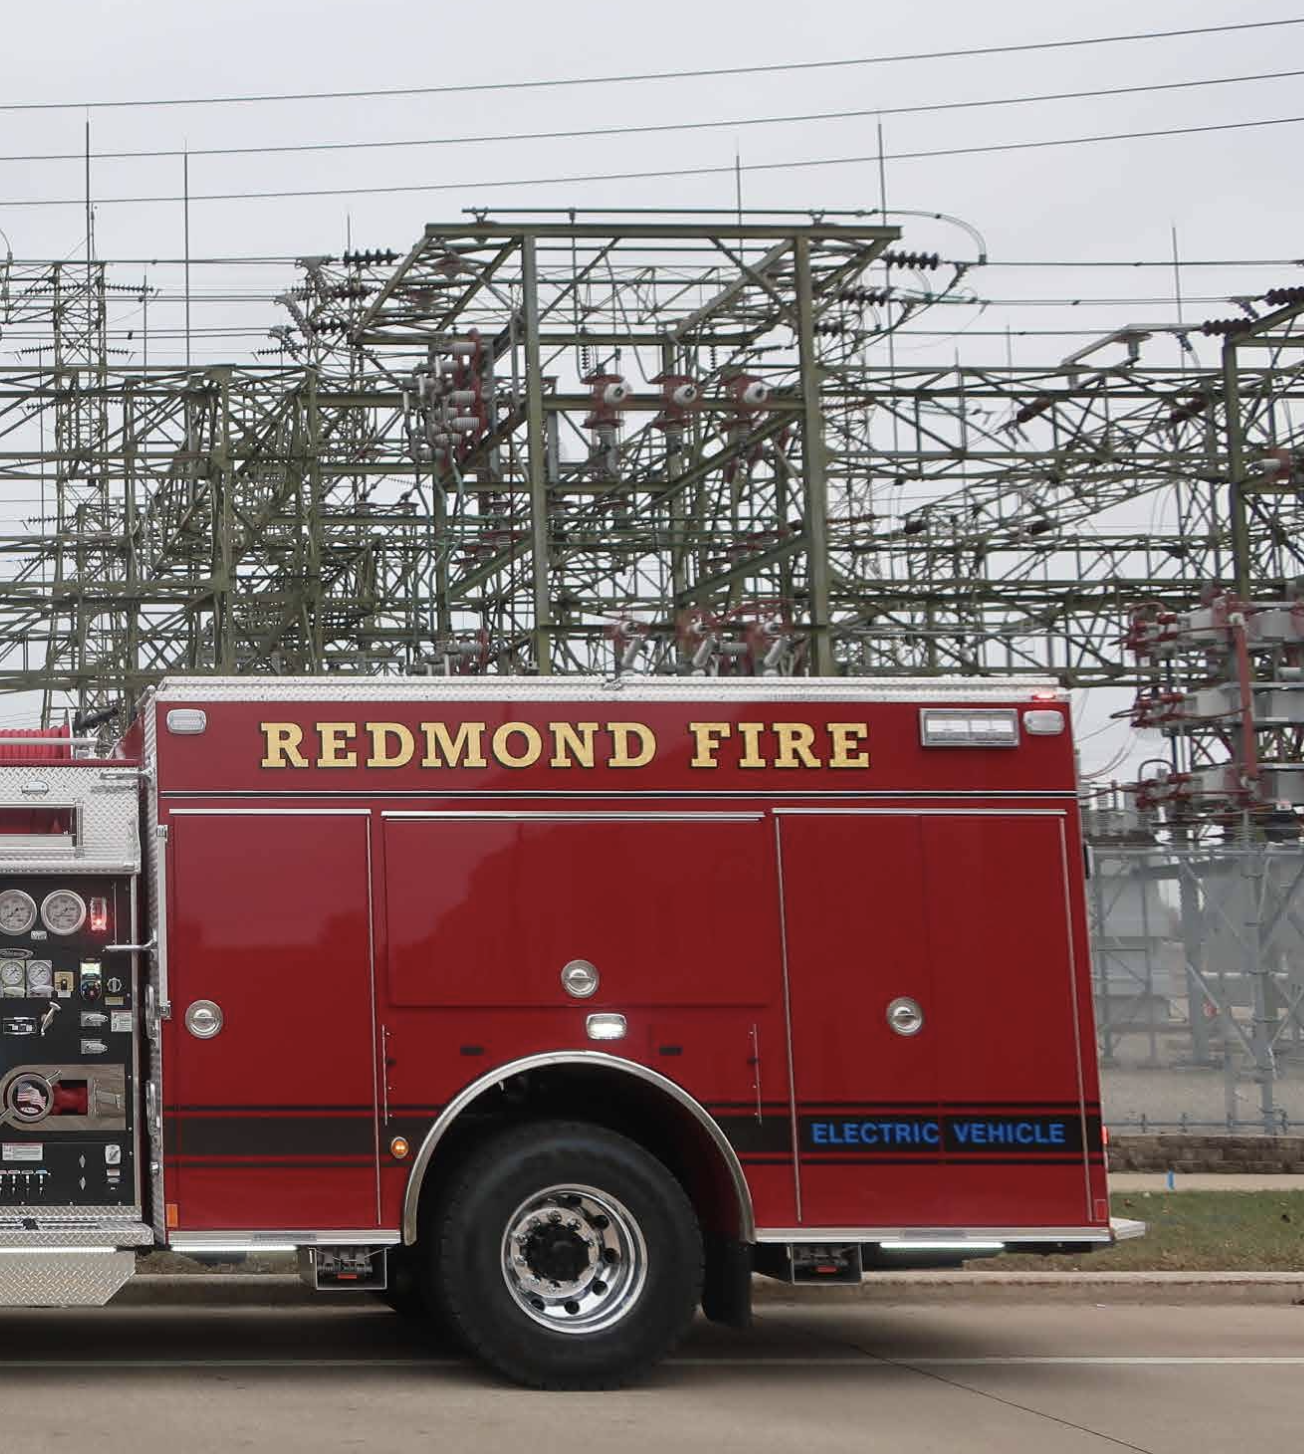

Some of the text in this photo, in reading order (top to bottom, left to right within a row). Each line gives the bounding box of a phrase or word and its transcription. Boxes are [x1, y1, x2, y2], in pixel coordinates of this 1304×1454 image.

[260, 721, 870, 769] REDMOND FIRE
[811, 1122, 1066, 1144] ELECTRIC VEHICLE
